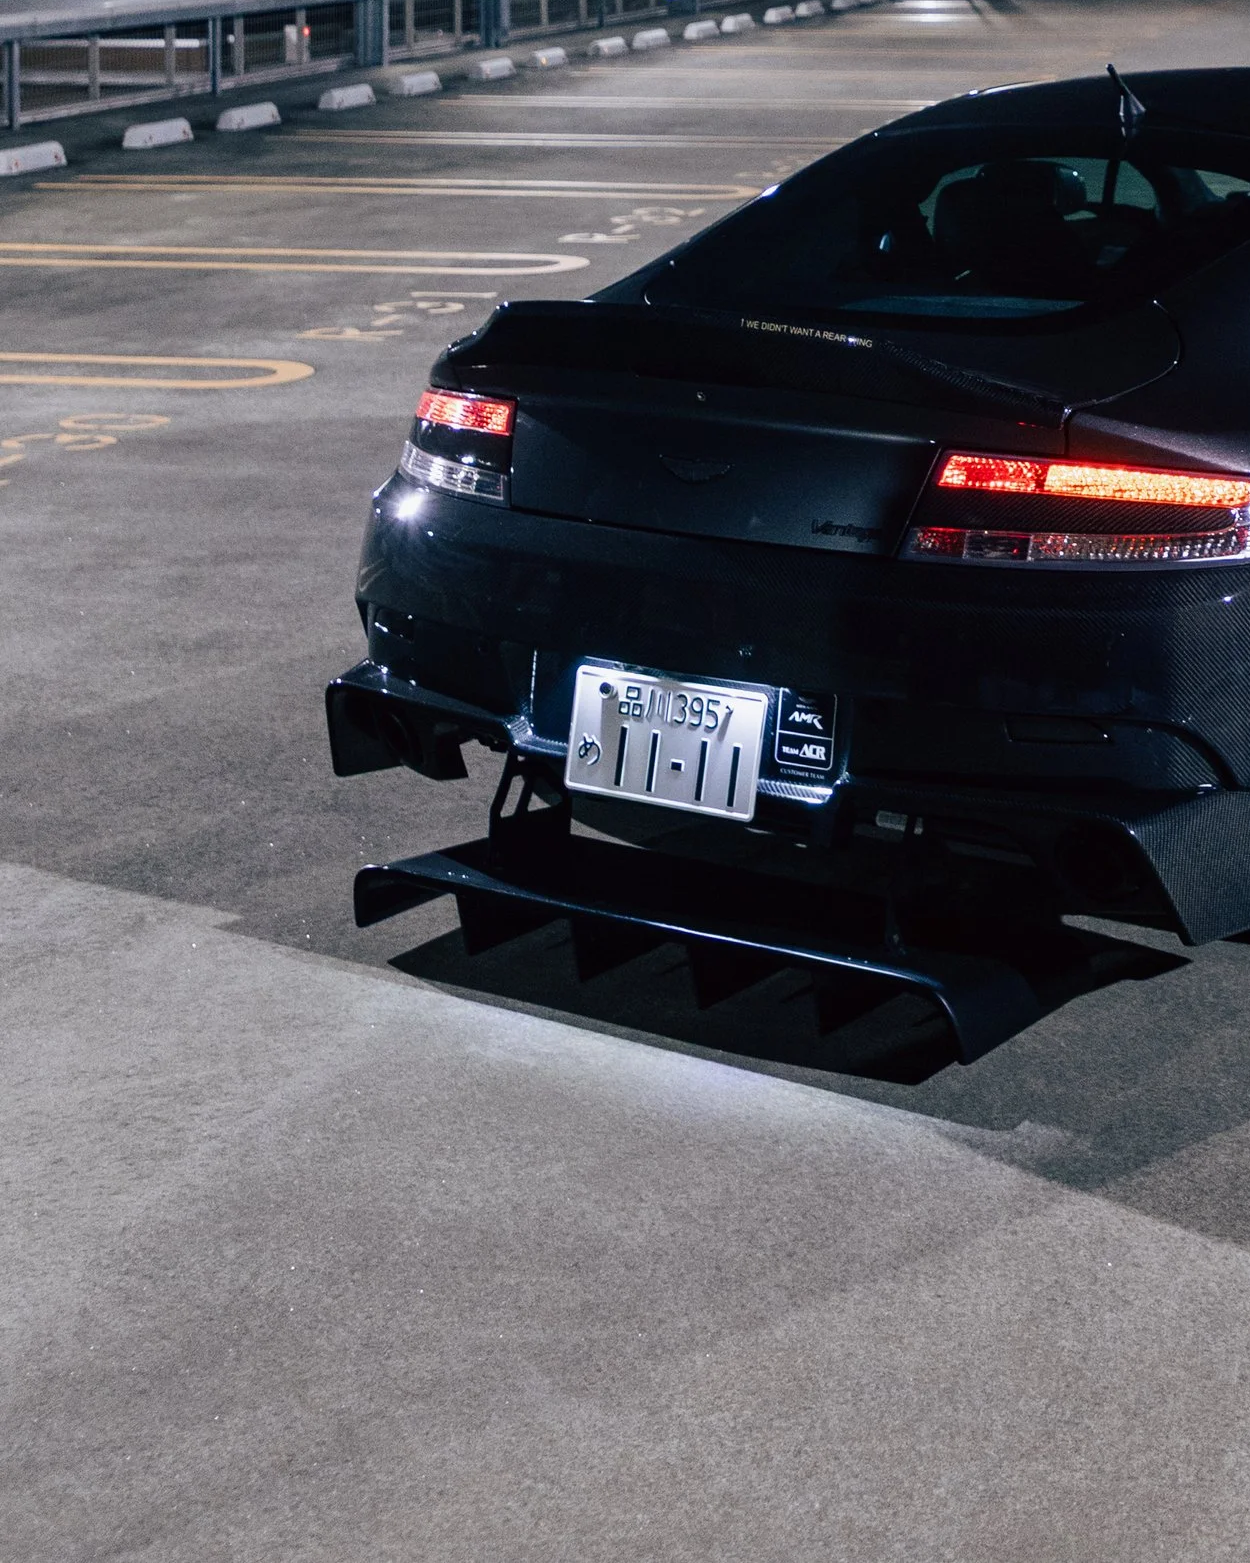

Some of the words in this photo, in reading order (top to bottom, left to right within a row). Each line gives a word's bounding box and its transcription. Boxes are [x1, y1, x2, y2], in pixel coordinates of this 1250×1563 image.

[746, 320, 760, 330] WE
[761, 322, 788, 334] DIDN'T
[790, 326, 814, 338] WANT
[815, 330, 822, 338] A
[822, 331, 847, 343] REAR
[788, 710, 824, 730] AMR
[781, 745, 799, 756] TEAM
[799, 743, 827, 761] ACR
[613, 724, 744, 809] 11-11
